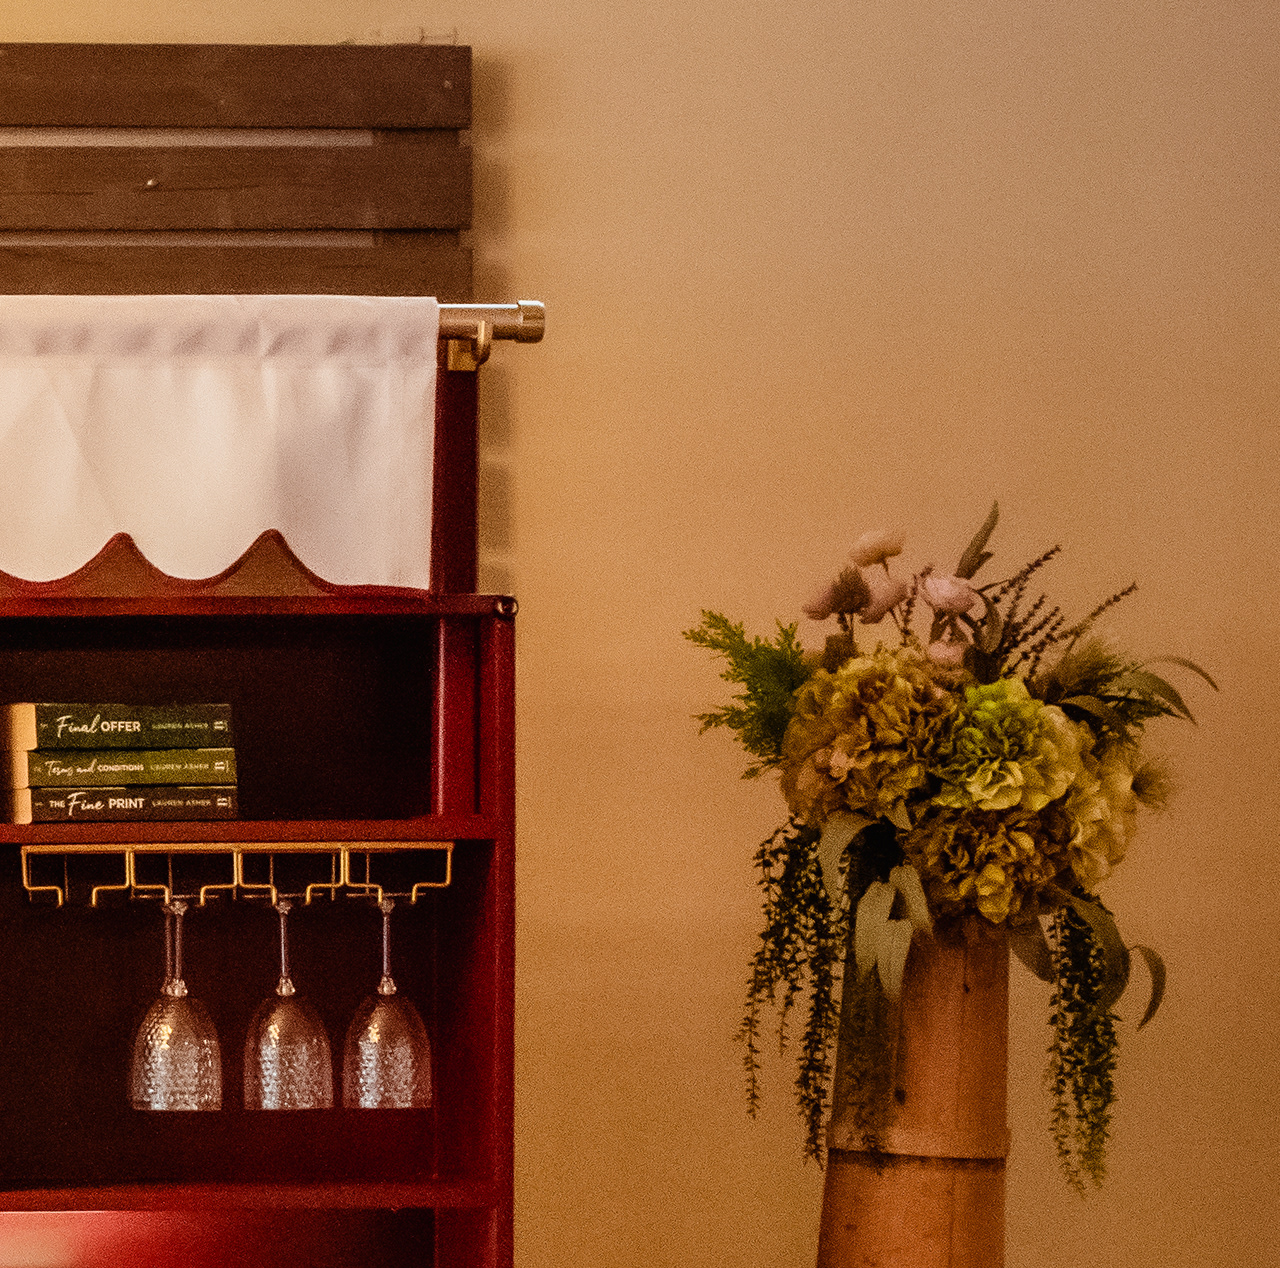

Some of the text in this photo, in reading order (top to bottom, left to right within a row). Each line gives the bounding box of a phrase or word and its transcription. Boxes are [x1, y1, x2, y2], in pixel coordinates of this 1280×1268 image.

[56, 713, 101, 739] Final
[100, 720, 141, 733] OFFER
[49, 799, 66, 809] THE
[67, 791, 104, 816] Fine
[108, 797, 144, 809] PRINT
